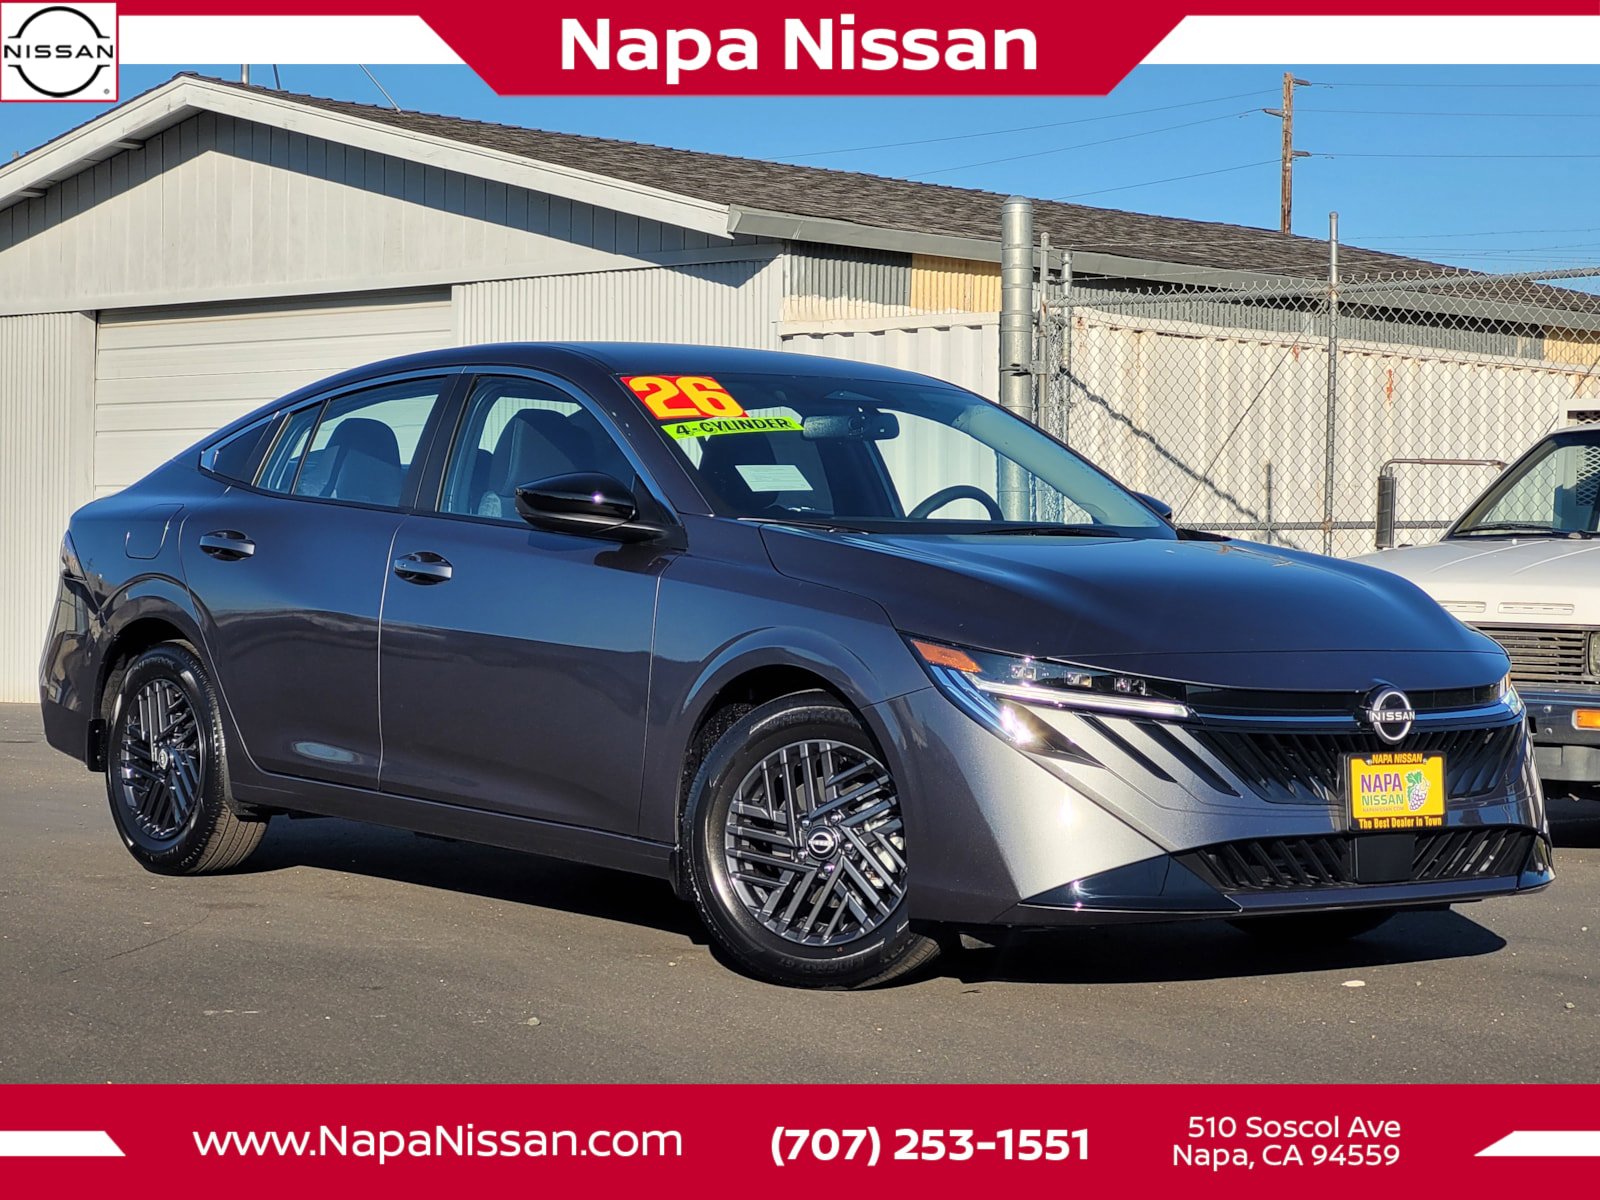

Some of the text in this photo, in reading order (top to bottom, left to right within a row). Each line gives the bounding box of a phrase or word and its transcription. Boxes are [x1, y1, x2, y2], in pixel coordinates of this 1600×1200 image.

[629, 376, 744, 418] 26
[676, 418, 789, 435] 4-CYLINDER
[1370, 711, 1416, 721] NISSAN
[1372, 753, 1423, 764] NAPA NISSAN
[1361, 773, 1403, 793] NAPA
[1362, 794, 1404, 806] NISSAN
[1359, 819, 1372, 829] The
[1374, 818, 1390, 828] Best
[1392, 817, 1414, 828] Dealer
[1425, 816, 1442, 826] Town
